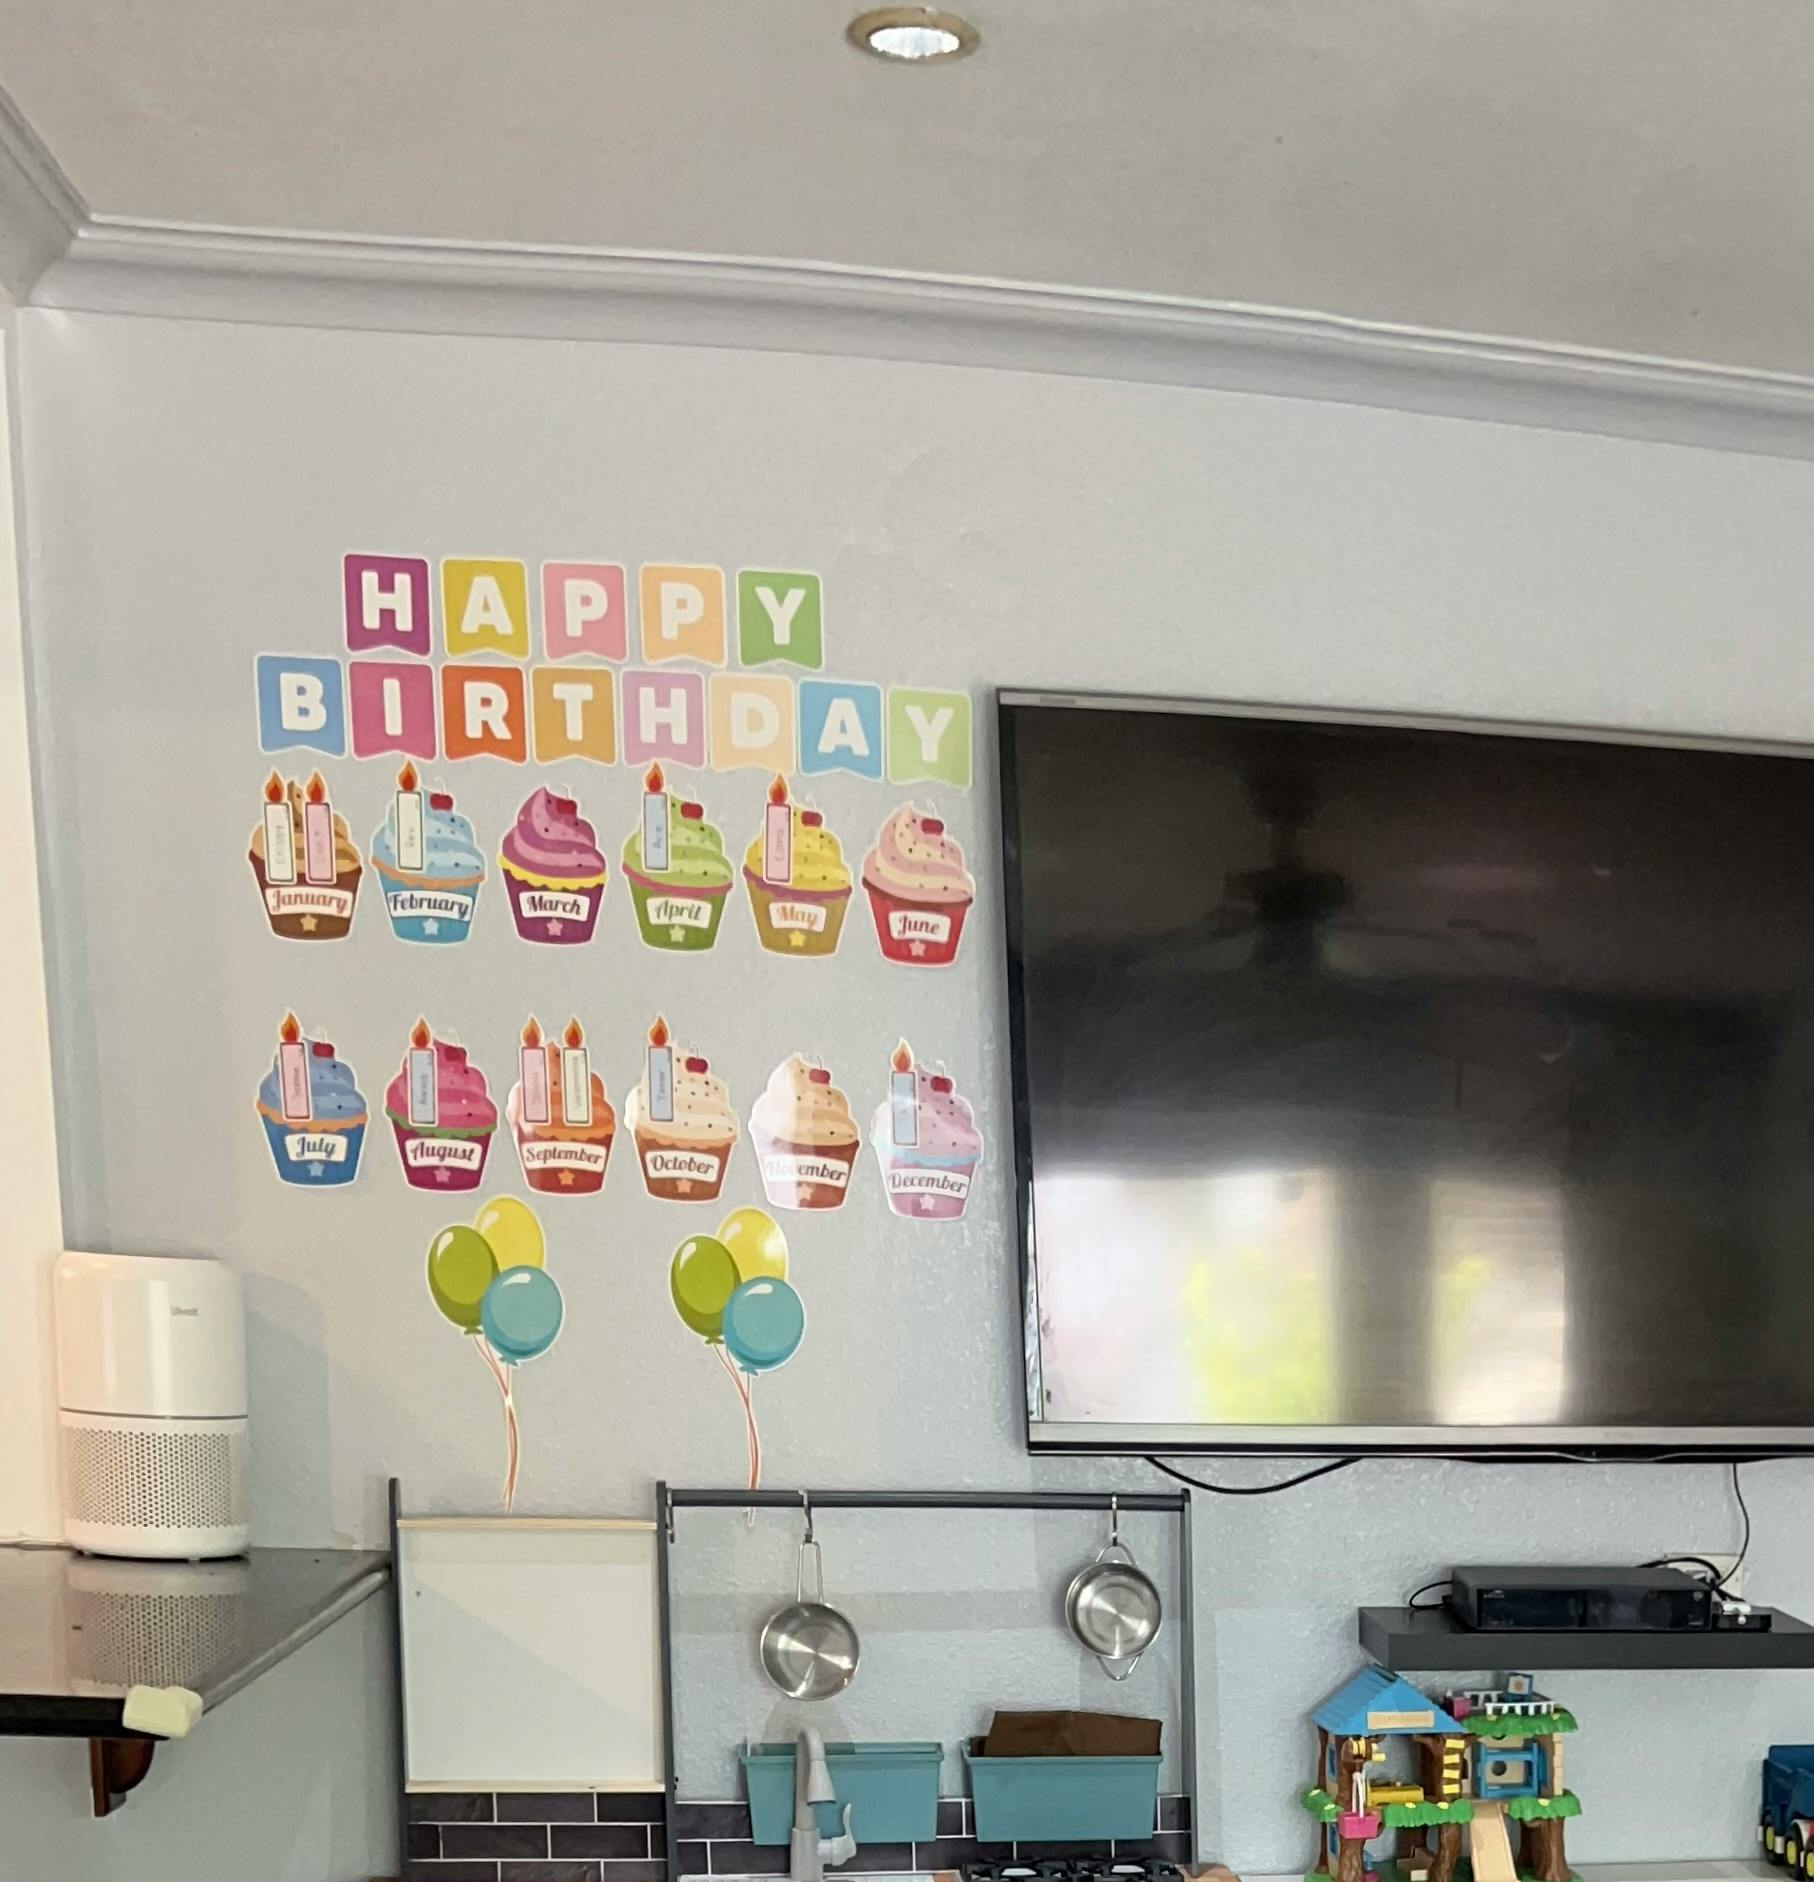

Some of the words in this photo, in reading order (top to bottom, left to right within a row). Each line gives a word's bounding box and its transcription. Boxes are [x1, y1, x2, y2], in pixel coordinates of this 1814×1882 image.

[360, 570, 808, 648] HAPPY
[280, 673, 953, 762] BIRTHDAY
[270, 889, 349, 916] January
[388, 891, 469, 921] February
[527, 892, 582, 916] March
[655, 898, 702, 922] April
[777, 904, 819, 929] May
[889, 914, 940, 937] June
[296, 1136, 336, 1161] July
[410, 1140, 476, 1164] August
[525, 1143, 603, 1167] September
[651, 1154, 715, 1177] October
[889, 1172, 964, 1195] December
